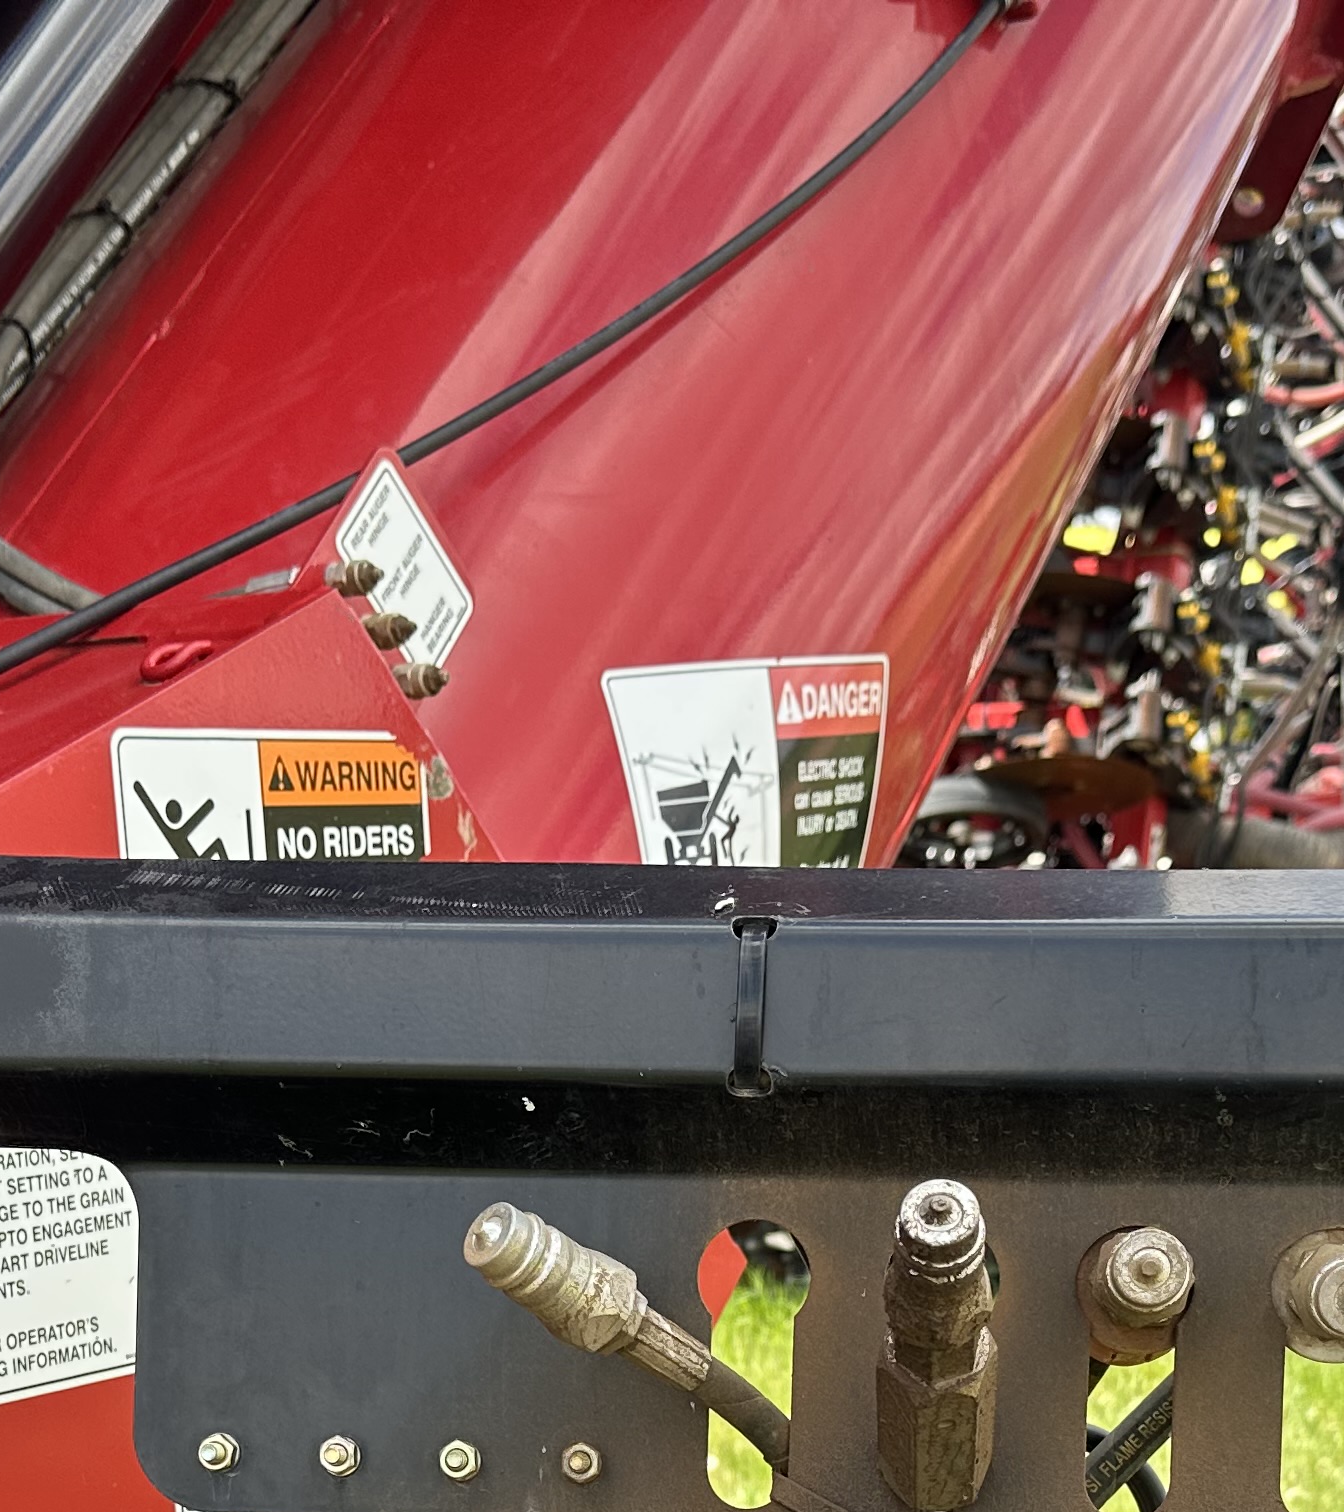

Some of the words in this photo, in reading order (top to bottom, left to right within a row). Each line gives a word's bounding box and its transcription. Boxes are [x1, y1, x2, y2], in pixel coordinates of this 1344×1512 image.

[801, 681, 882, 718] DANGER
[295, 759, 416, 792] WARNING
[276, 827, 317, 859] NO
[323, 823, 416, 859] RIDERS
[6, 1170, 71, 1196] SETTING
[73, 1167, 94, 1185] TO
[98, 1164, 108, 1182] A
[23, 1200, 43, 1218] TO
[47, 1194, 76, 1215] THE
[80, 1186, 125, 1209] GRAIN
[32, 1210, 133, 1242] ENGAGEMENT
[33, 1238, 110, 1269] DRIVELINE
[6, 1316, 99, 1350] OPERATOR'S
[12, 1336, 118, 1375] INFORMATION.
[1086, 1474, 1102, 1494] SI
[1099, 1431, 1143, 1479] FLAME
[1137, 1399, 1174, 1441] RESIS
